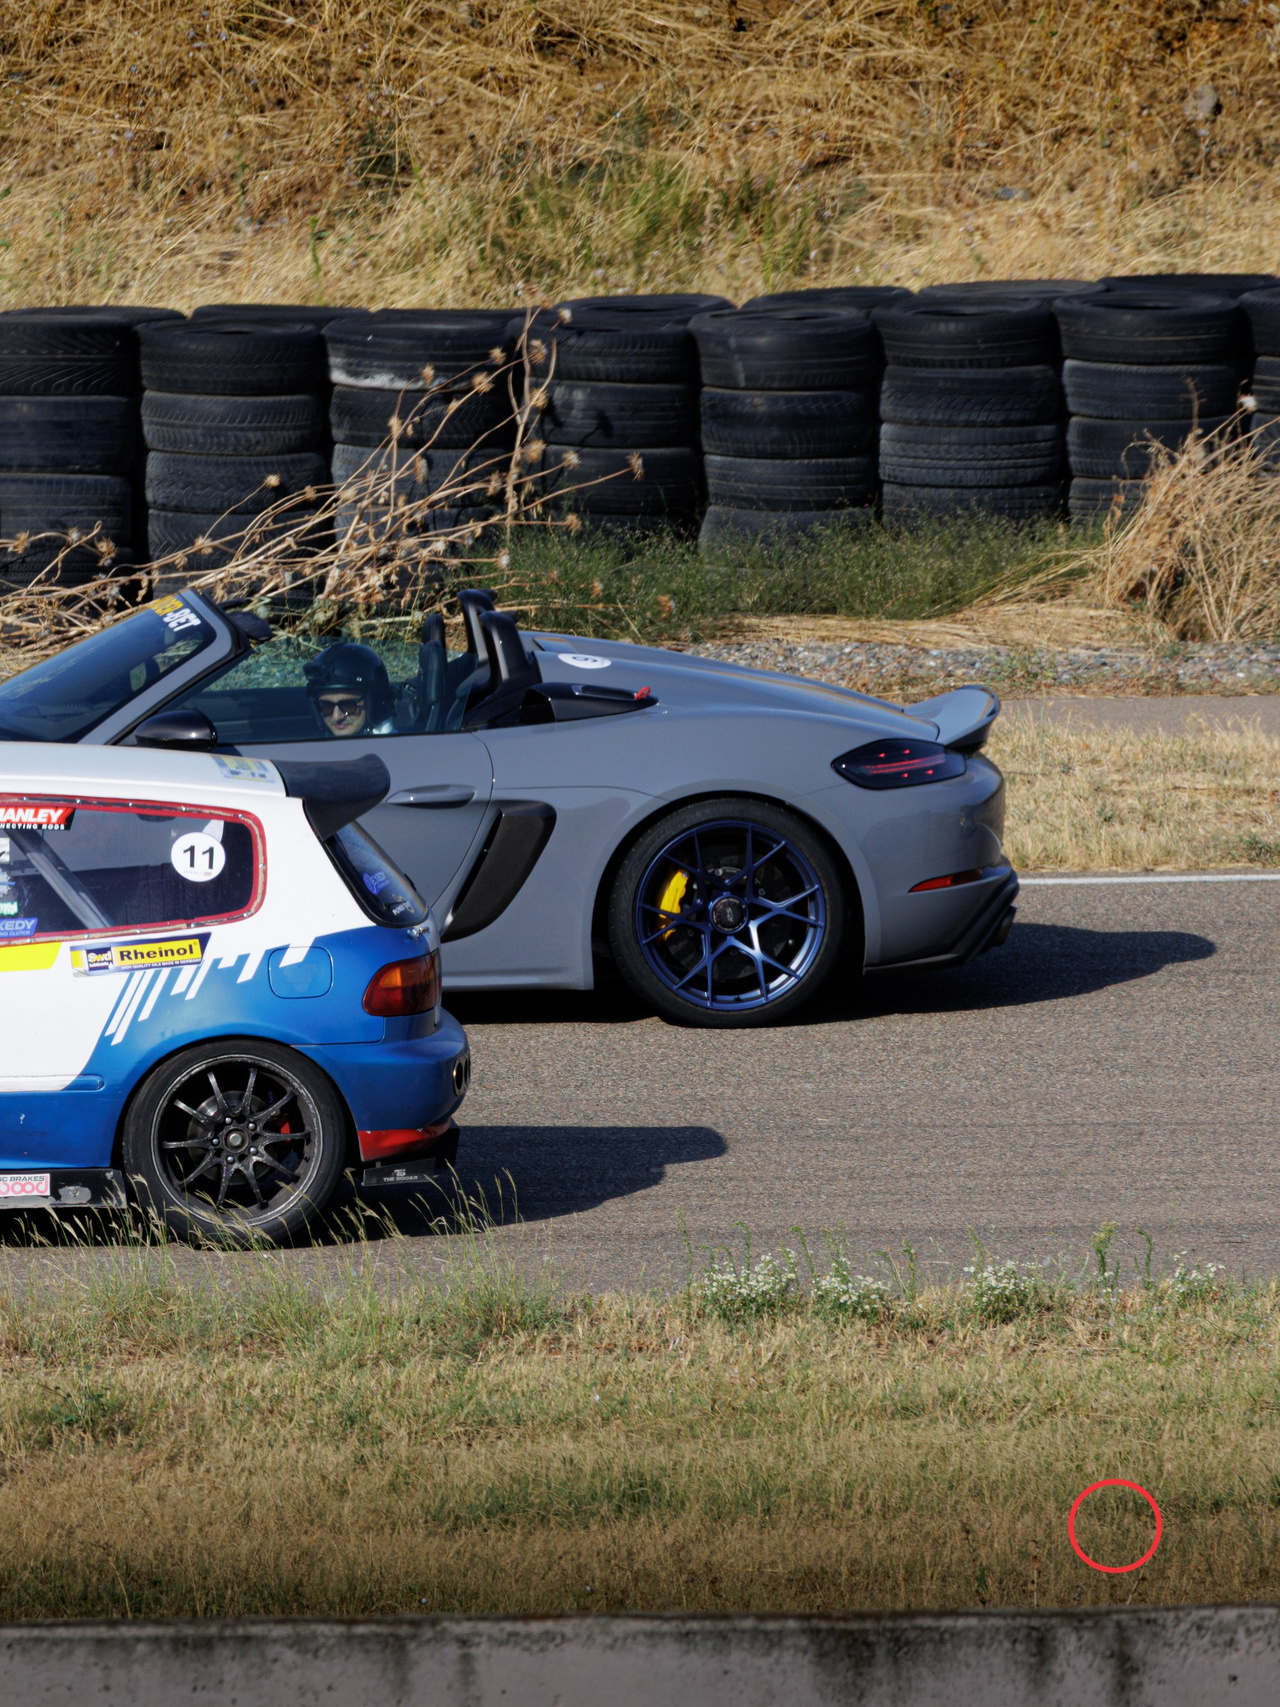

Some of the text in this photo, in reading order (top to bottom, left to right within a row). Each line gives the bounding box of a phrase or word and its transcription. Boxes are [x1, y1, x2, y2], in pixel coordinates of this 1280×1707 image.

[41, 823, 65, 831] RODS
[183, 845, 215, 870] 11
[9, 929, 32, 937] CLUTCH
[119, 943, 195, 962] Rheinol
